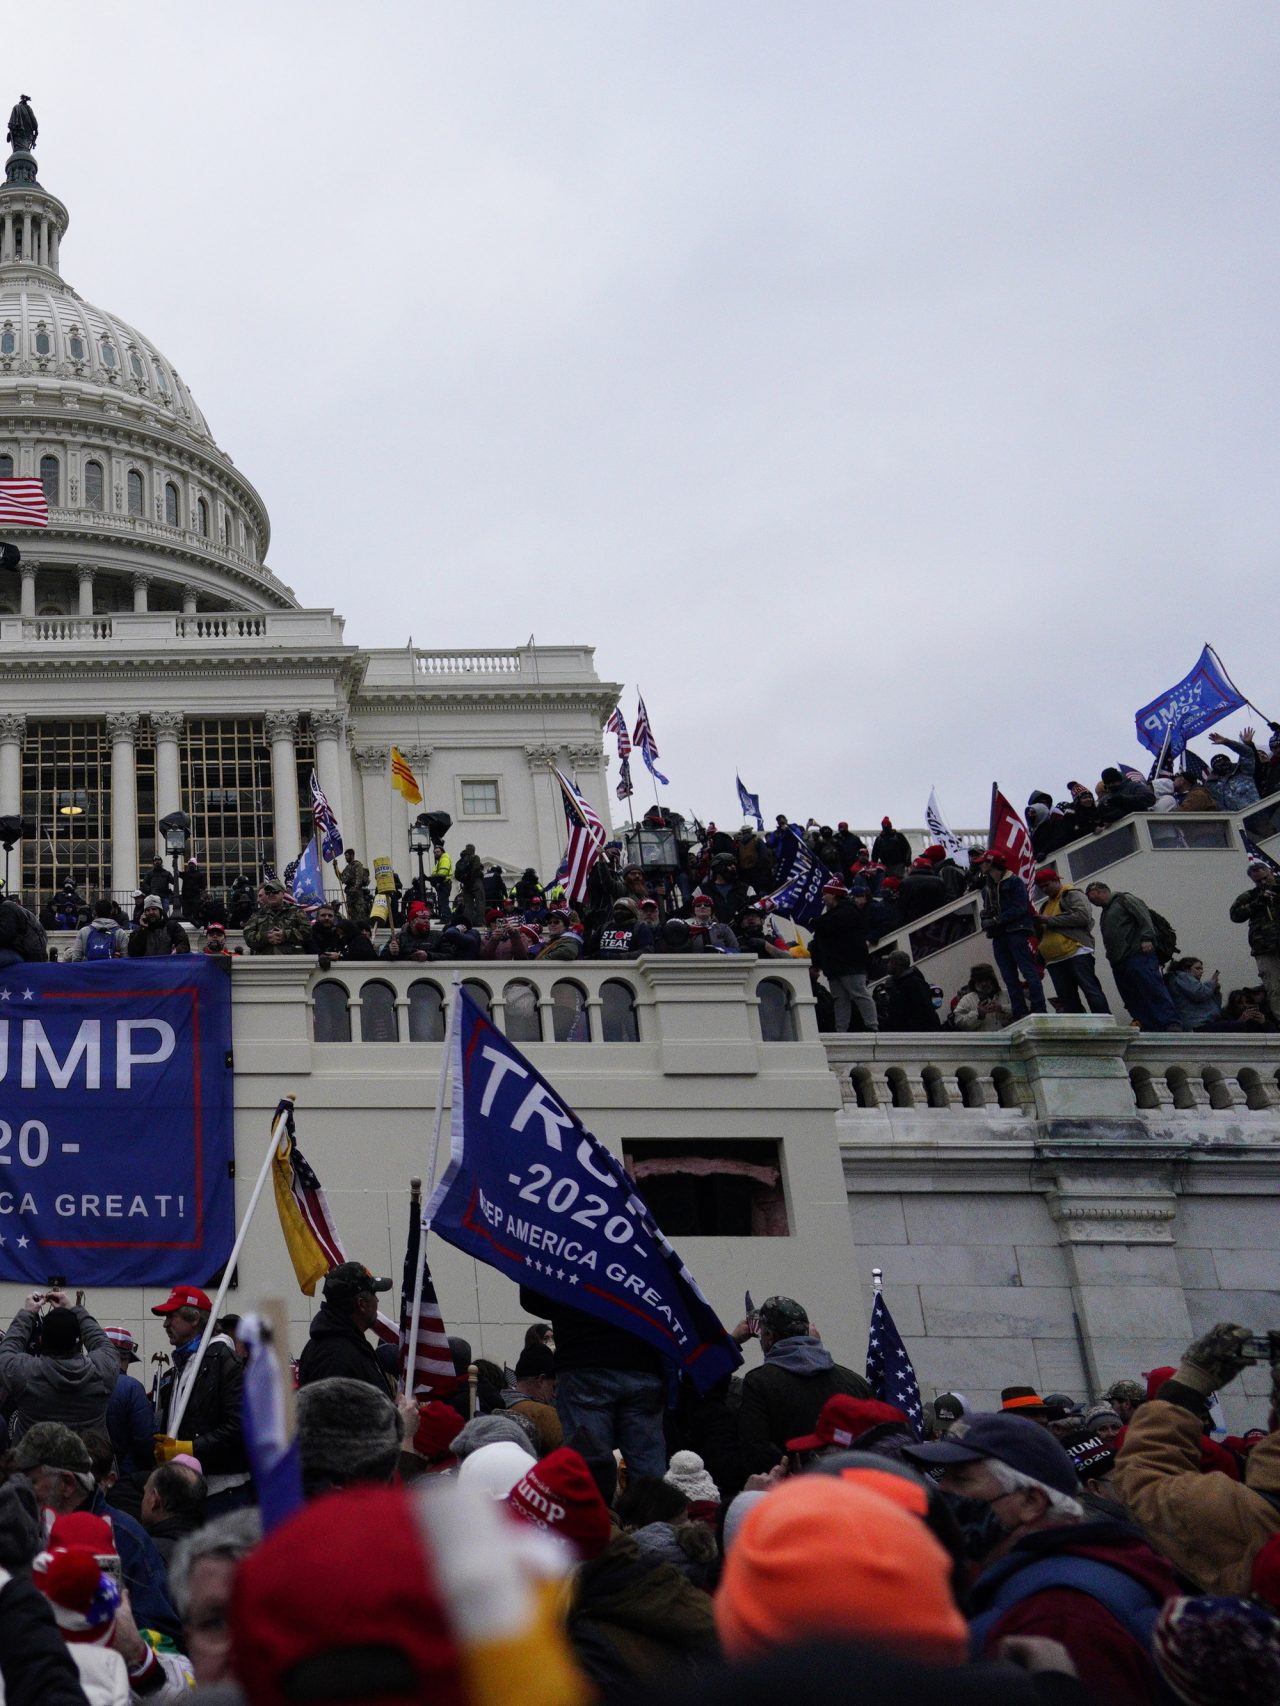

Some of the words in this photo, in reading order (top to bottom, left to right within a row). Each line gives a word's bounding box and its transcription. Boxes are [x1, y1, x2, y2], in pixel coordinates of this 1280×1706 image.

[600, 939, 629, 949] STEAL
[602, 930, 633, 940] STOP
[54, 1193, 185, 1218] GREAT!
[506, 1213, 600, 1272] AMERICA
[604, 1261, 689, 1346] GREAT!
[1076, 1450, 1111, 1471] 2020
